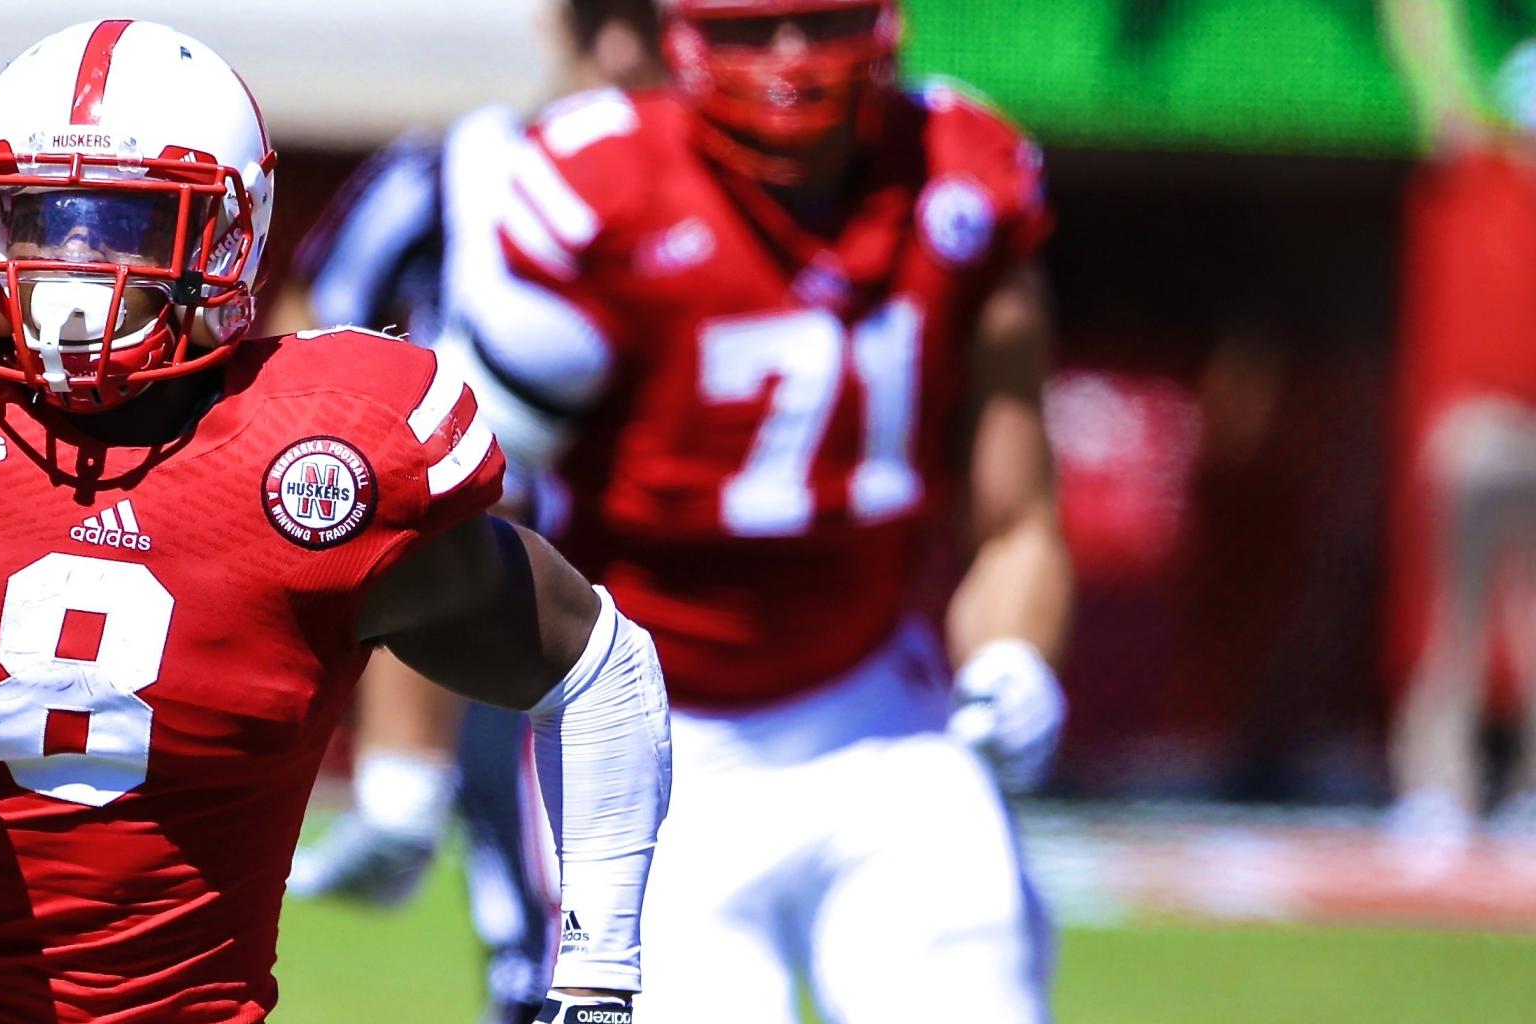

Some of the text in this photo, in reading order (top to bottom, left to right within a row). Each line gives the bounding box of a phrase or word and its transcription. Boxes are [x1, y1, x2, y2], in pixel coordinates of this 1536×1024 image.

[52, 134, 112, 149] HUSKERS
[209, 227, 243, 261] idde
[697, 296, 923, 538] 71
[270, 440, 370, 490] NEBRASKA FOOTBALL
[286, 482, 351, 502] HUSKERS
[268, 492, 367, 542] A WINNING TRADITION
[69, 524, 152, 551] adidas
